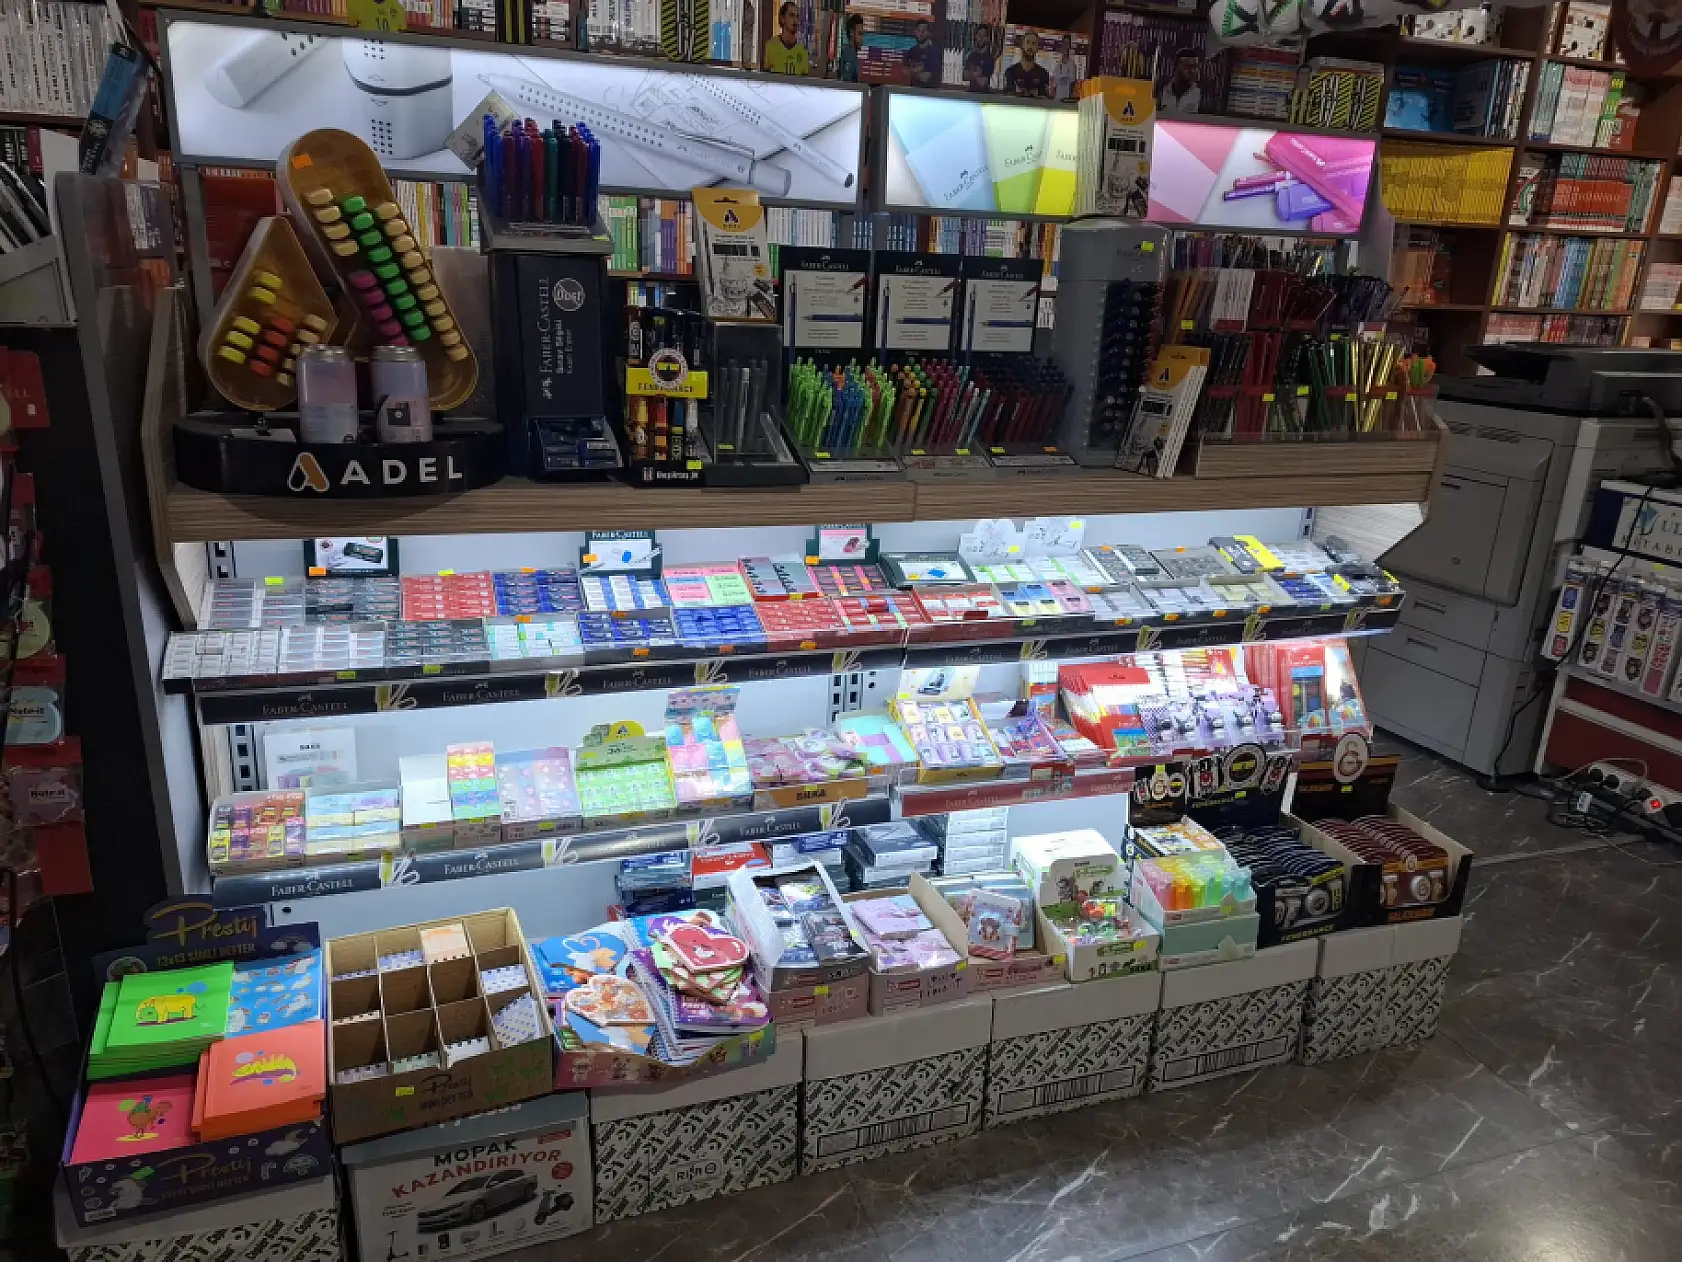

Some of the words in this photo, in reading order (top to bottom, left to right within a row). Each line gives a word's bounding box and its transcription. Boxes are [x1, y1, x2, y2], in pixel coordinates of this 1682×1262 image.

[537, 277, 553, 374] FABER-CASTELL
[340, 456, 463, 485] ADEL
[443, 688, 520, 703] FABER-CASTELL
[263, 701, 349, 716] FABER-CASTELL
[444, 857, 520, 876] FABER-CASTELL
[271, 878, 354, 897] FABER-CASTELL
[433, 1138, 519, 1167] MOPAK
[391, 1149, 562, 1199] KAZANDIRIYOR
